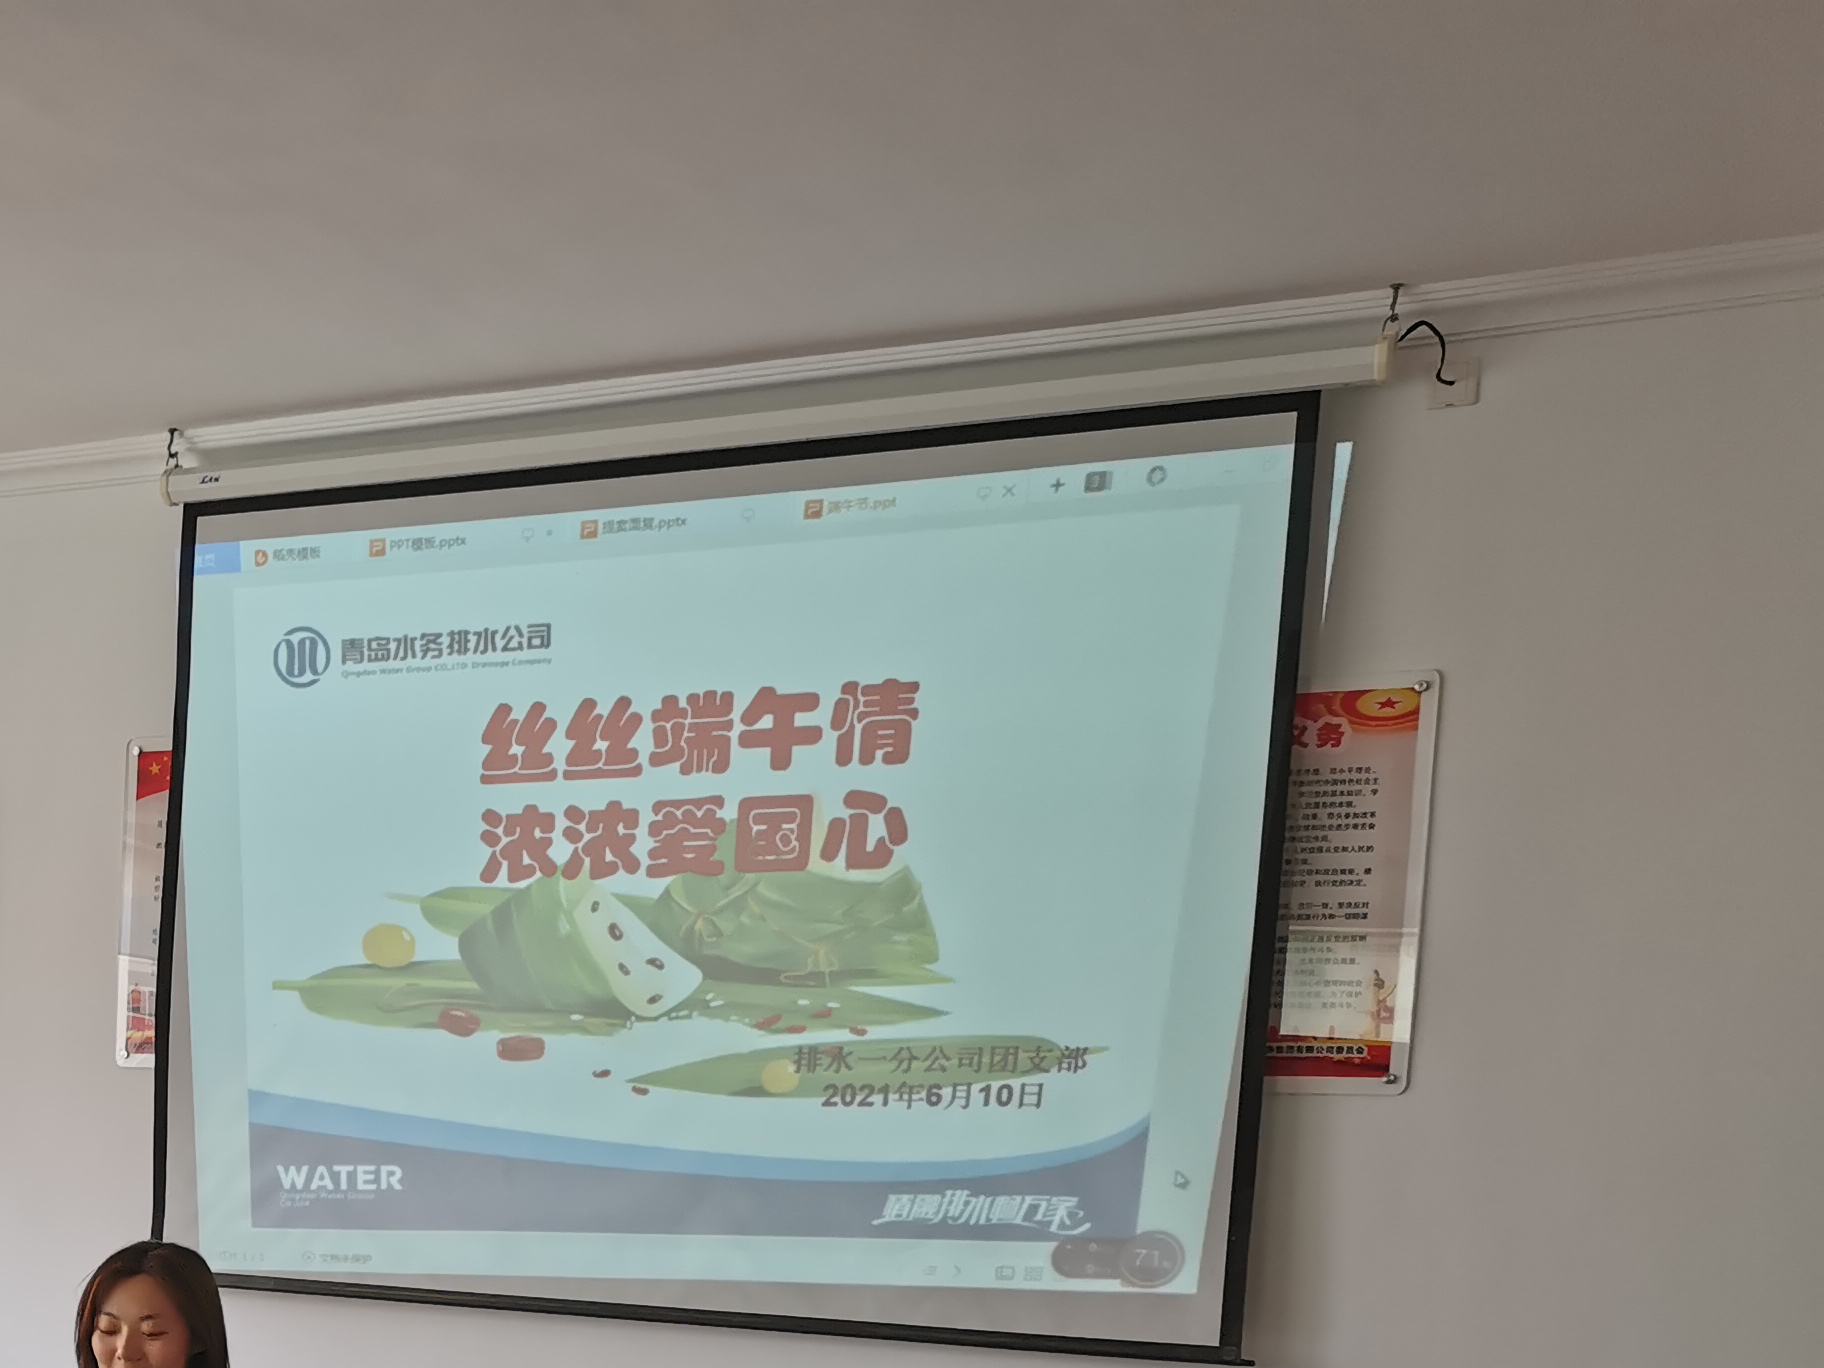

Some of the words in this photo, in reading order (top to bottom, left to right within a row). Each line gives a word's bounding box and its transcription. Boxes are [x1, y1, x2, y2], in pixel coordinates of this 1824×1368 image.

[341, 623, 552, 665] 青岛水务排水公司
[480, 678, 920, 785] 丝丝端午情
[480, 790, 908, 884] 浓浓爱国心
[792, 1045, 1090, 1076] 排水一分公司团支部
[821, 1081, 1045, 1111] 2021年6月10日
[276, 1165, 403, 1190] WATER
